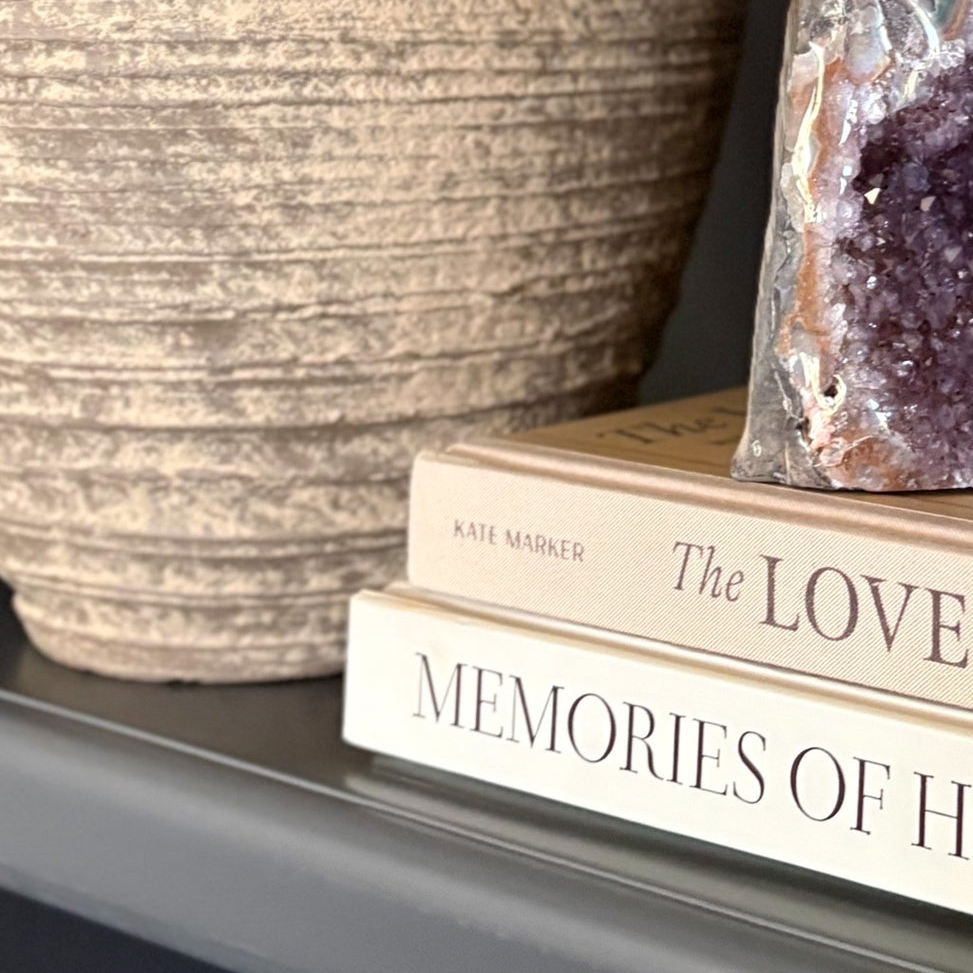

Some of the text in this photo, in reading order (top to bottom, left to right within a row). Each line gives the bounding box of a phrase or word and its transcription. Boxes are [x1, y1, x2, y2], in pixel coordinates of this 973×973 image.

[596, 415, 728, 444] The
[453, 518, 585, 562] KATE MARKER
[672, 541, 745, 603] The
[757, 553, 969, 669] LOVE
[413, 652, 767, 804] MEMORIES
[790, 746, 892, 835] OF
